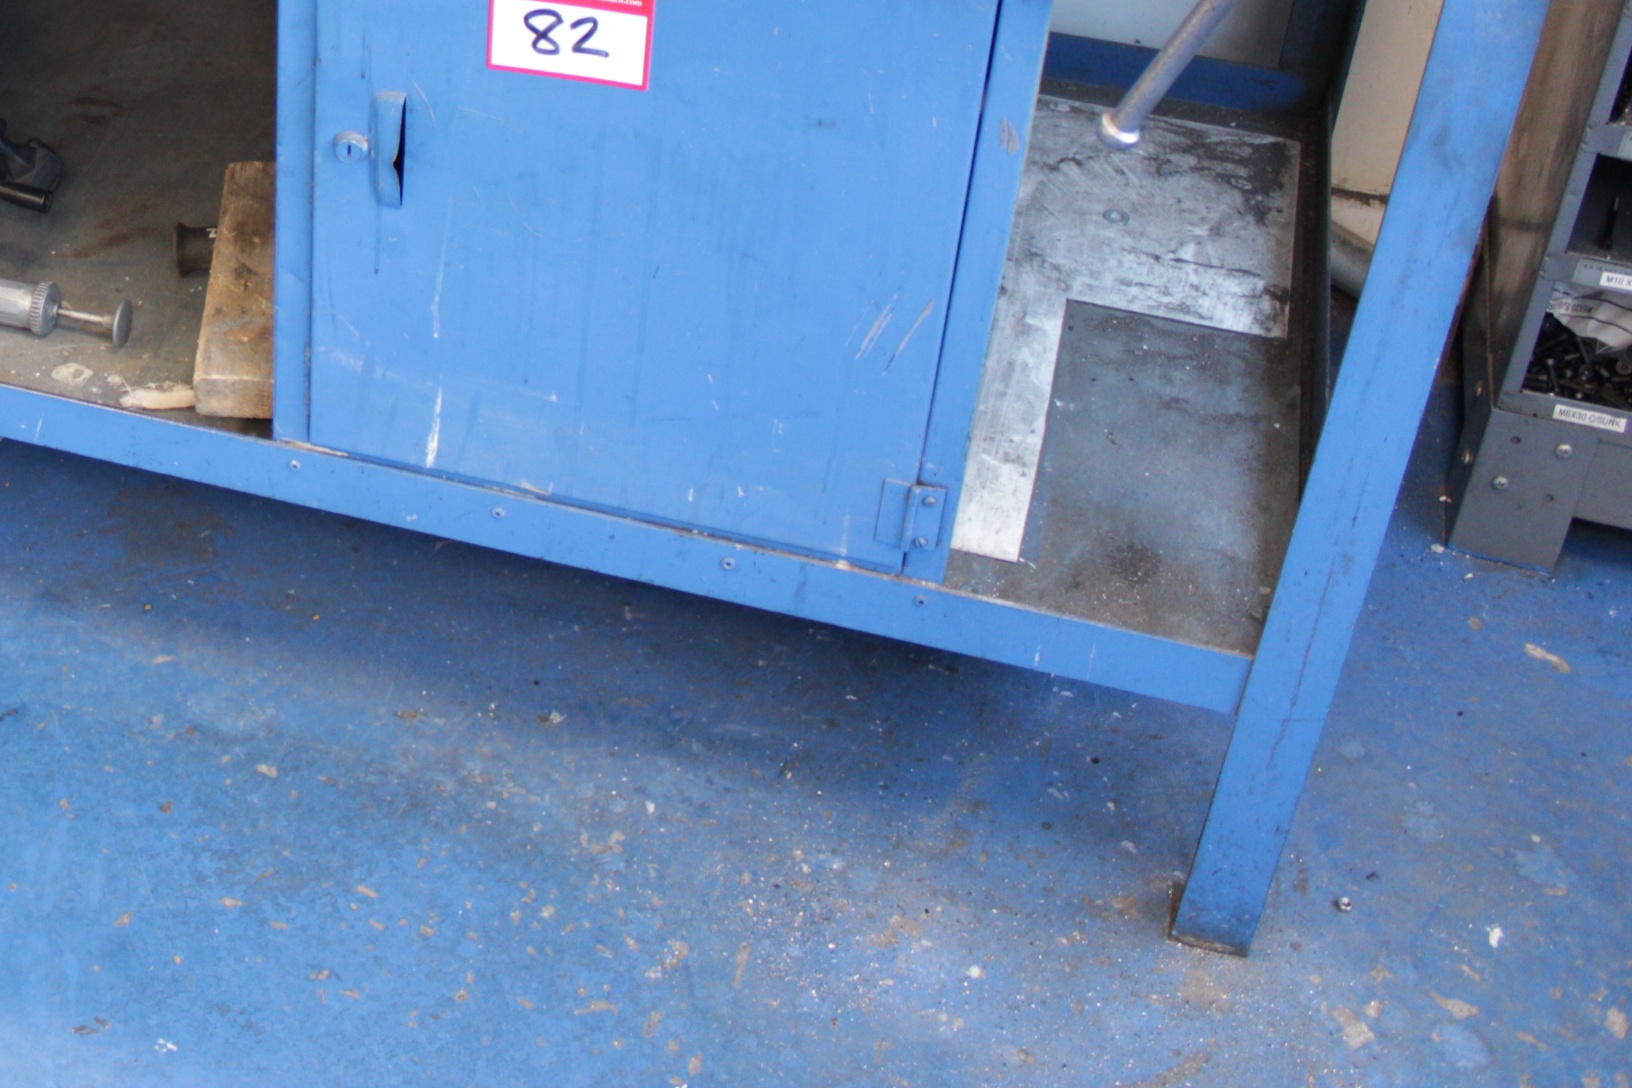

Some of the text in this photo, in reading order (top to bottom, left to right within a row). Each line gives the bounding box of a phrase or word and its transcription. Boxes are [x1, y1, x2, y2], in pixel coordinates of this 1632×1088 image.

[524, 8, 610, 58] 82
[1605, 275, 1624, 286] M10
[1558, 408, 1622, 428] M6X30 C/SUNK
